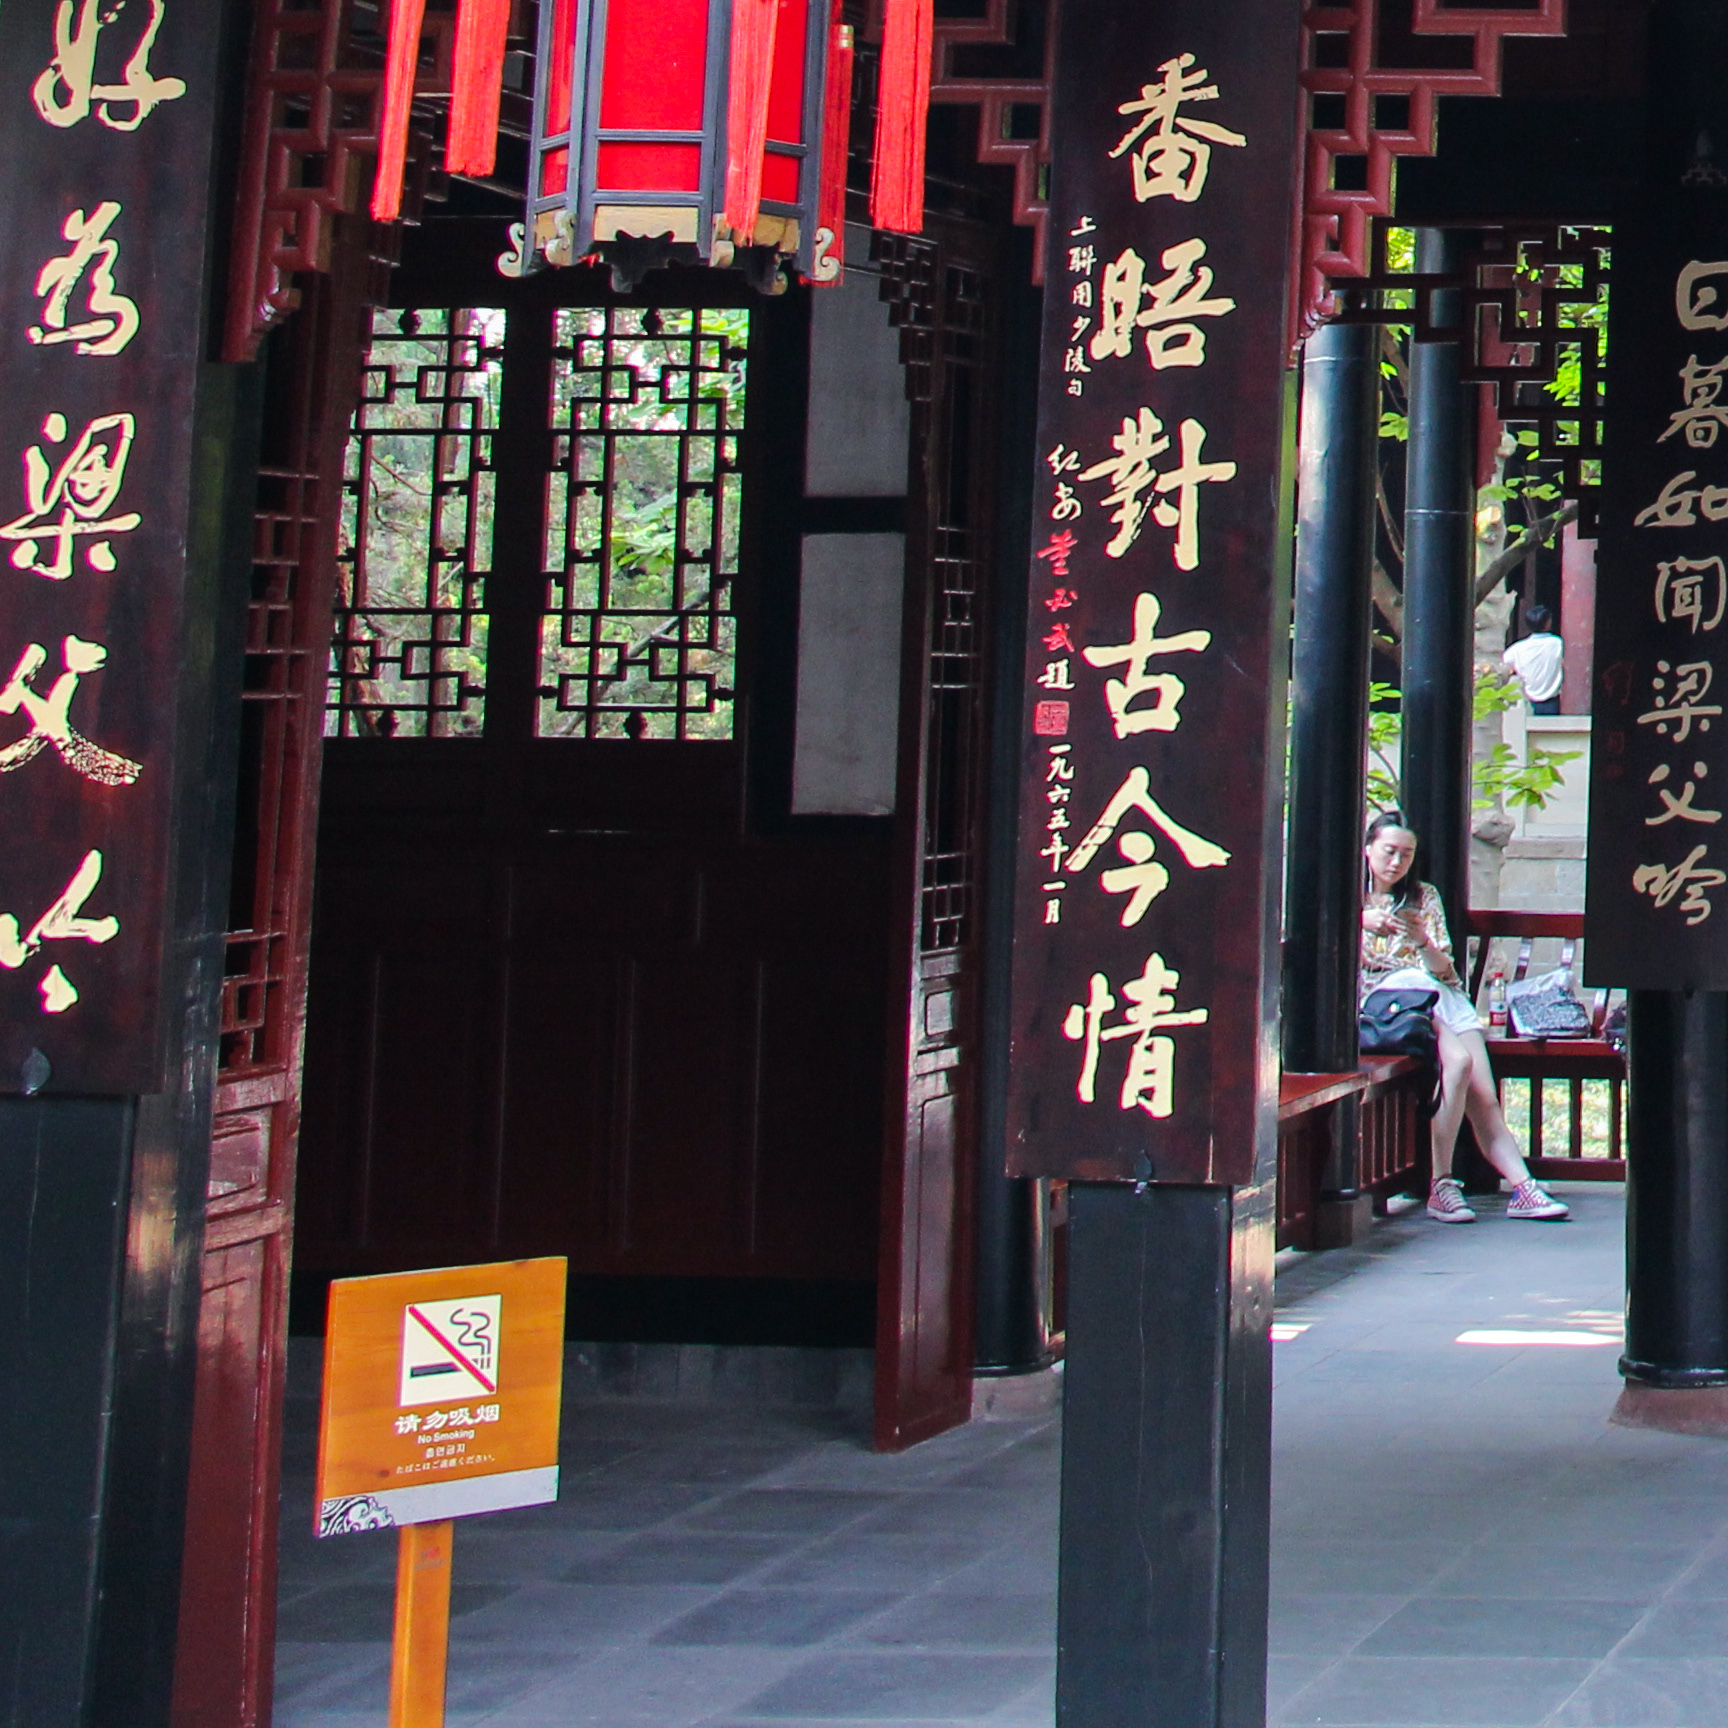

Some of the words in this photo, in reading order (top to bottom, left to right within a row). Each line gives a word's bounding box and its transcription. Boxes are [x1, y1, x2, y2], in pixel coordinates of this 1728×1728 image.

[394, 1403, 500, 1434] 请勿吸烟
[417, 1434, 432, 1444] No
[434, 1429, 475, 1442] Smoking
